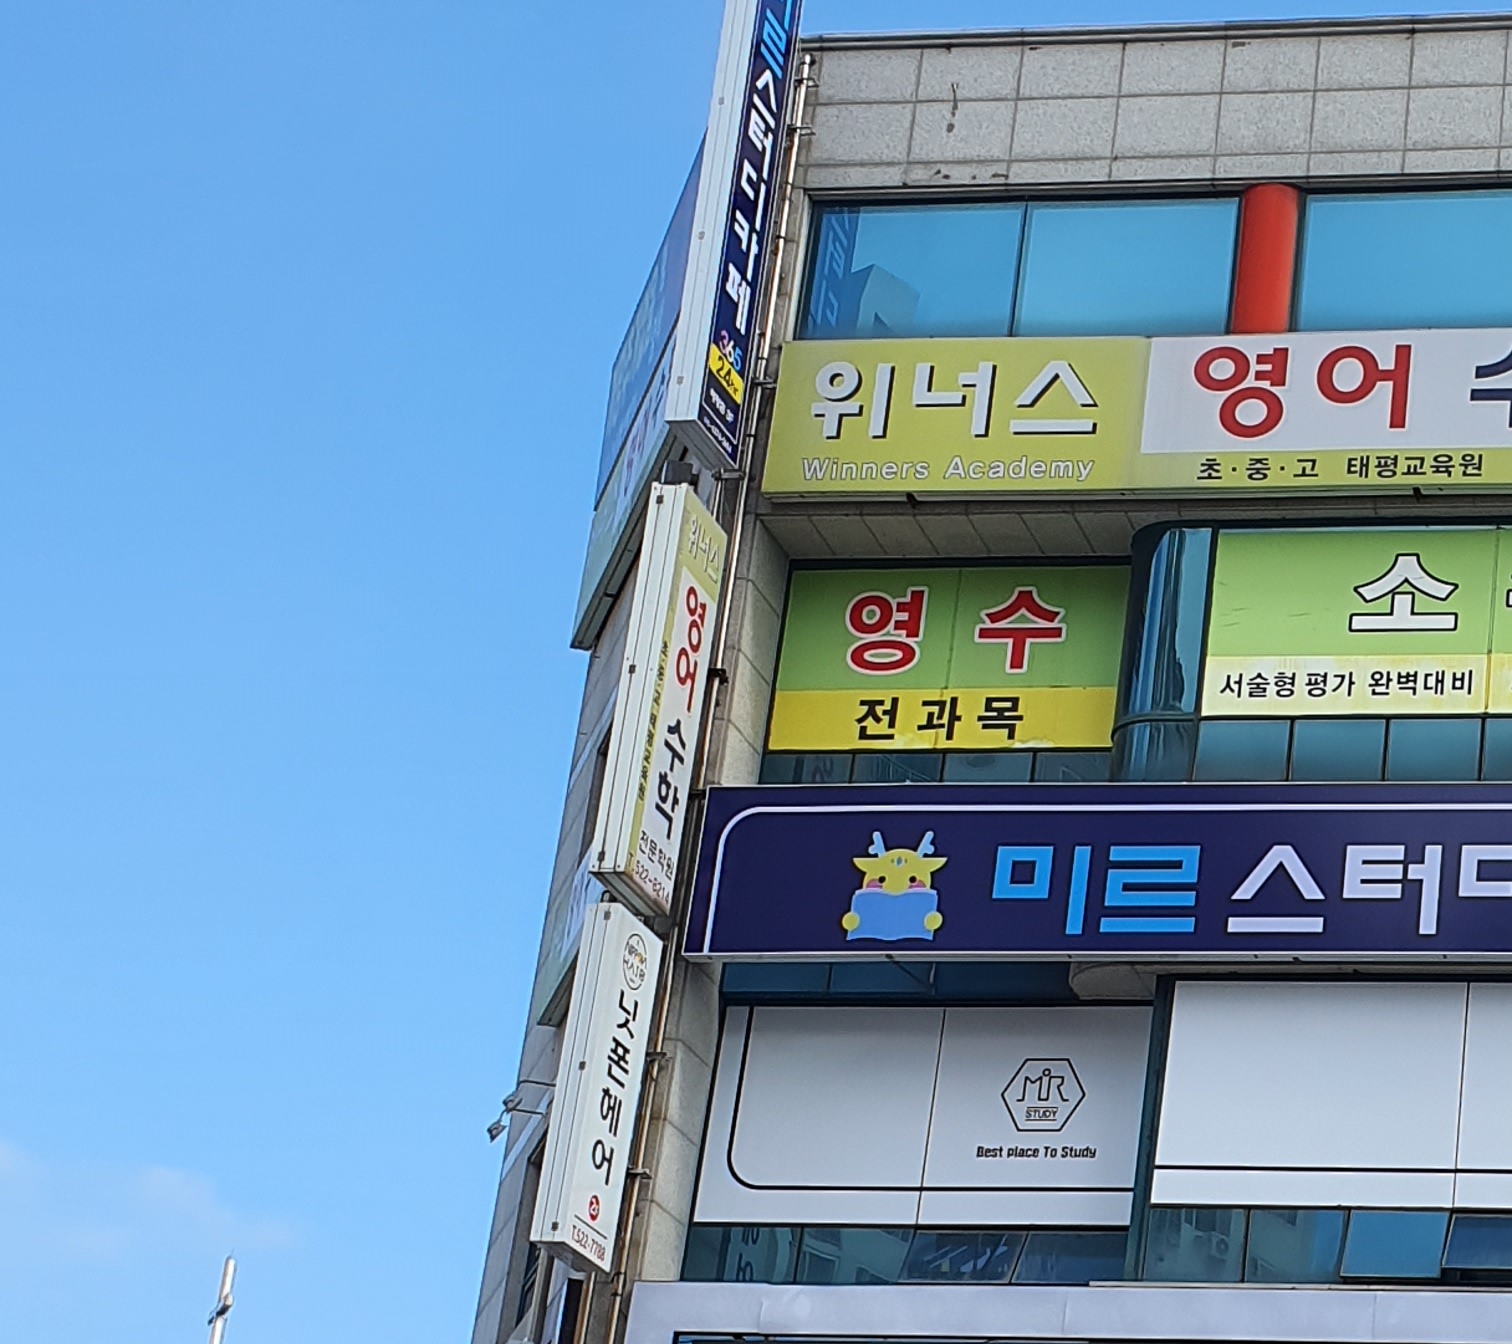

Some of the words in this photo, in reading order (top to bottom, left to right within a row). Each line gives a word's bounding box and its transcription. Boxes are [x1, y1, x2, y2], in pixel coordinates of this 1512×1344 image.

[811, 360, 1099, 440] 위너스
[1192, 343, 1412, 440] 영어
[802, 457, 930, 482] Winners
[944, 455, 1095, 483] Academy
[1346, 452, 1485, 480] 태평교육원
[687, 516, 721, 585] 위너스
[675, 585, 708, 714] 영어
[1219, 670, 1297, 699] 서술형
[1303, 669, 1356, 698] 평가
[1367, 667, 1475, 697] 완벽대비
[854, 695, 1025, 742] 전과목
[654, 718, 687, 842] 수학
[639, 829, 675, 883] 전문학원
[590, 988, 640, 1187] 닛폰헤어
[1024, 1107, 1058, 1120] STUDY
[976, 1145, 1003, 1159] Best
[1006, 1145, 1039, 1162] place
[1043, 1144, 1058, 1159] To
[1060, 1144, 1097, 1162] Study
